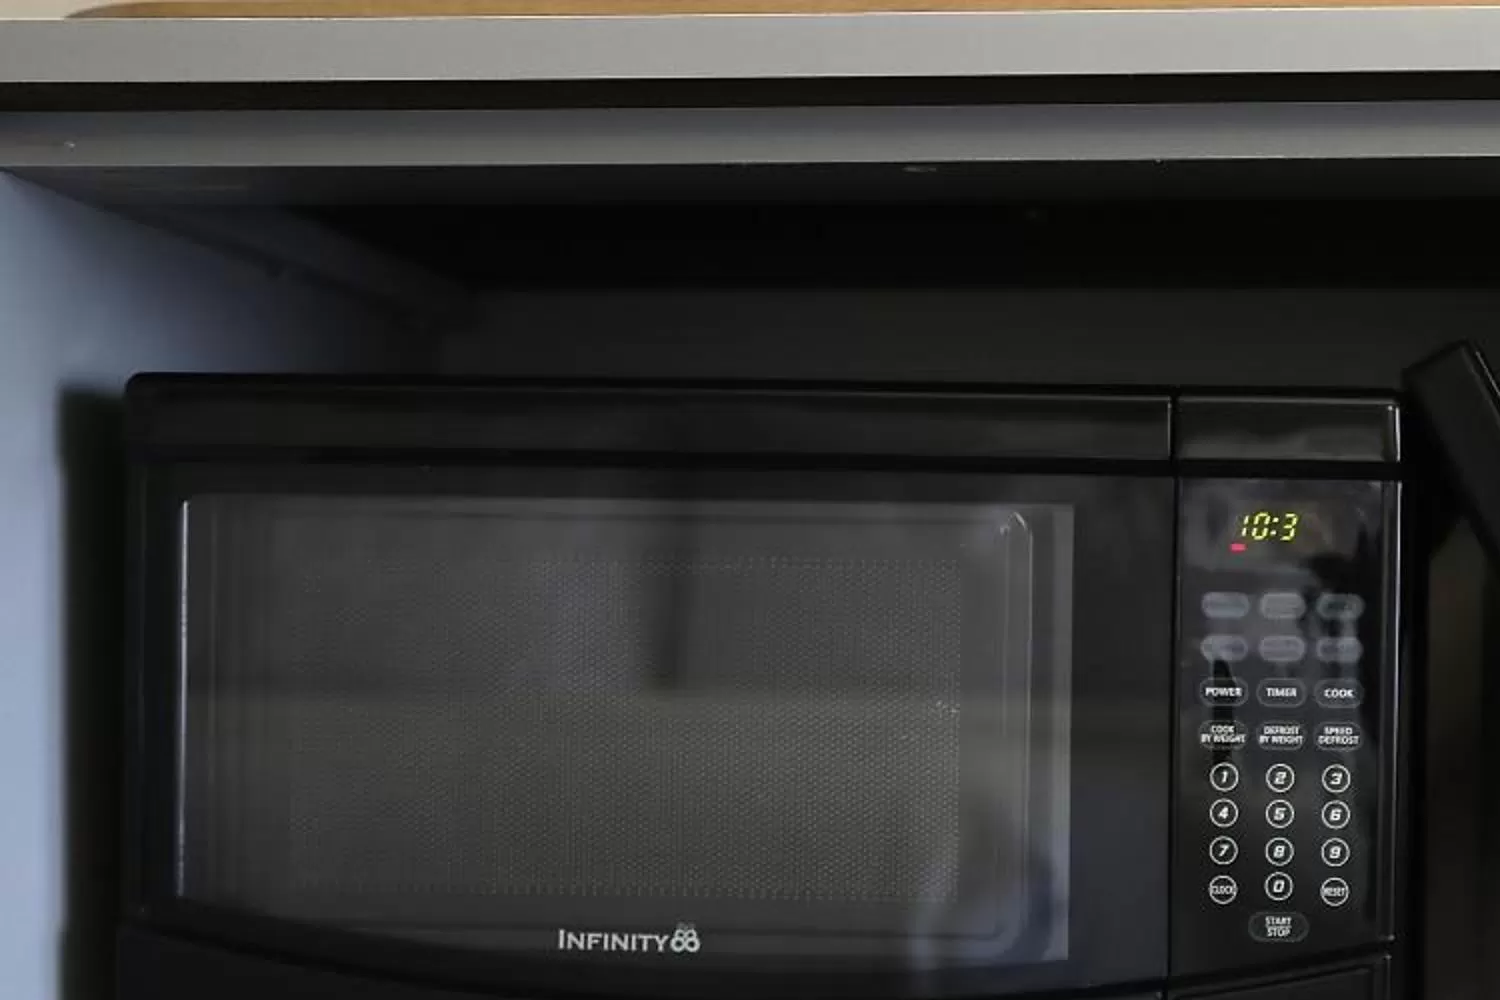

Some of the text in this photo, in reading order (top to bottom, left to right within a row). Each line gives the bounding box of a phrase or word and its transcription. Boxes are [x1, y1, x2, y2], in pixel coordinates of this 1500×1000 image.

[1205, 687, 1242, 697] POWER
[1265, 687, 1297, 697] TIMER
[1324, 688, 1355, 699] COOK
[1211, 725, 1236, 734] COOK
[1263, 726, 1300, 735] DEFROST
[1201, 734, 1212, 744] BY
[1259, 735, 1304, 745] BY WEIGHT
[1318, 736, 1360, 745] DEFROST
[1220, 771, 1228, 784] 1
[1274, 771, 1287, 785] 2
[1330, 772, 1343, 785] 3
[1218, 806, 1229, 819] 4
[1274, 807, 1287, 821] 5
[1329, 808, 1342, 821] 6
[1218, 844, 1230, 857] 7
[1273, 845, 1285, 858] 8
[1329, 845, 1342, 859] 9
[1273, 879, 1285, 893] 0
[1264, 916, 1292, 926] START
[1266, 927, 1291, 937] STOP
